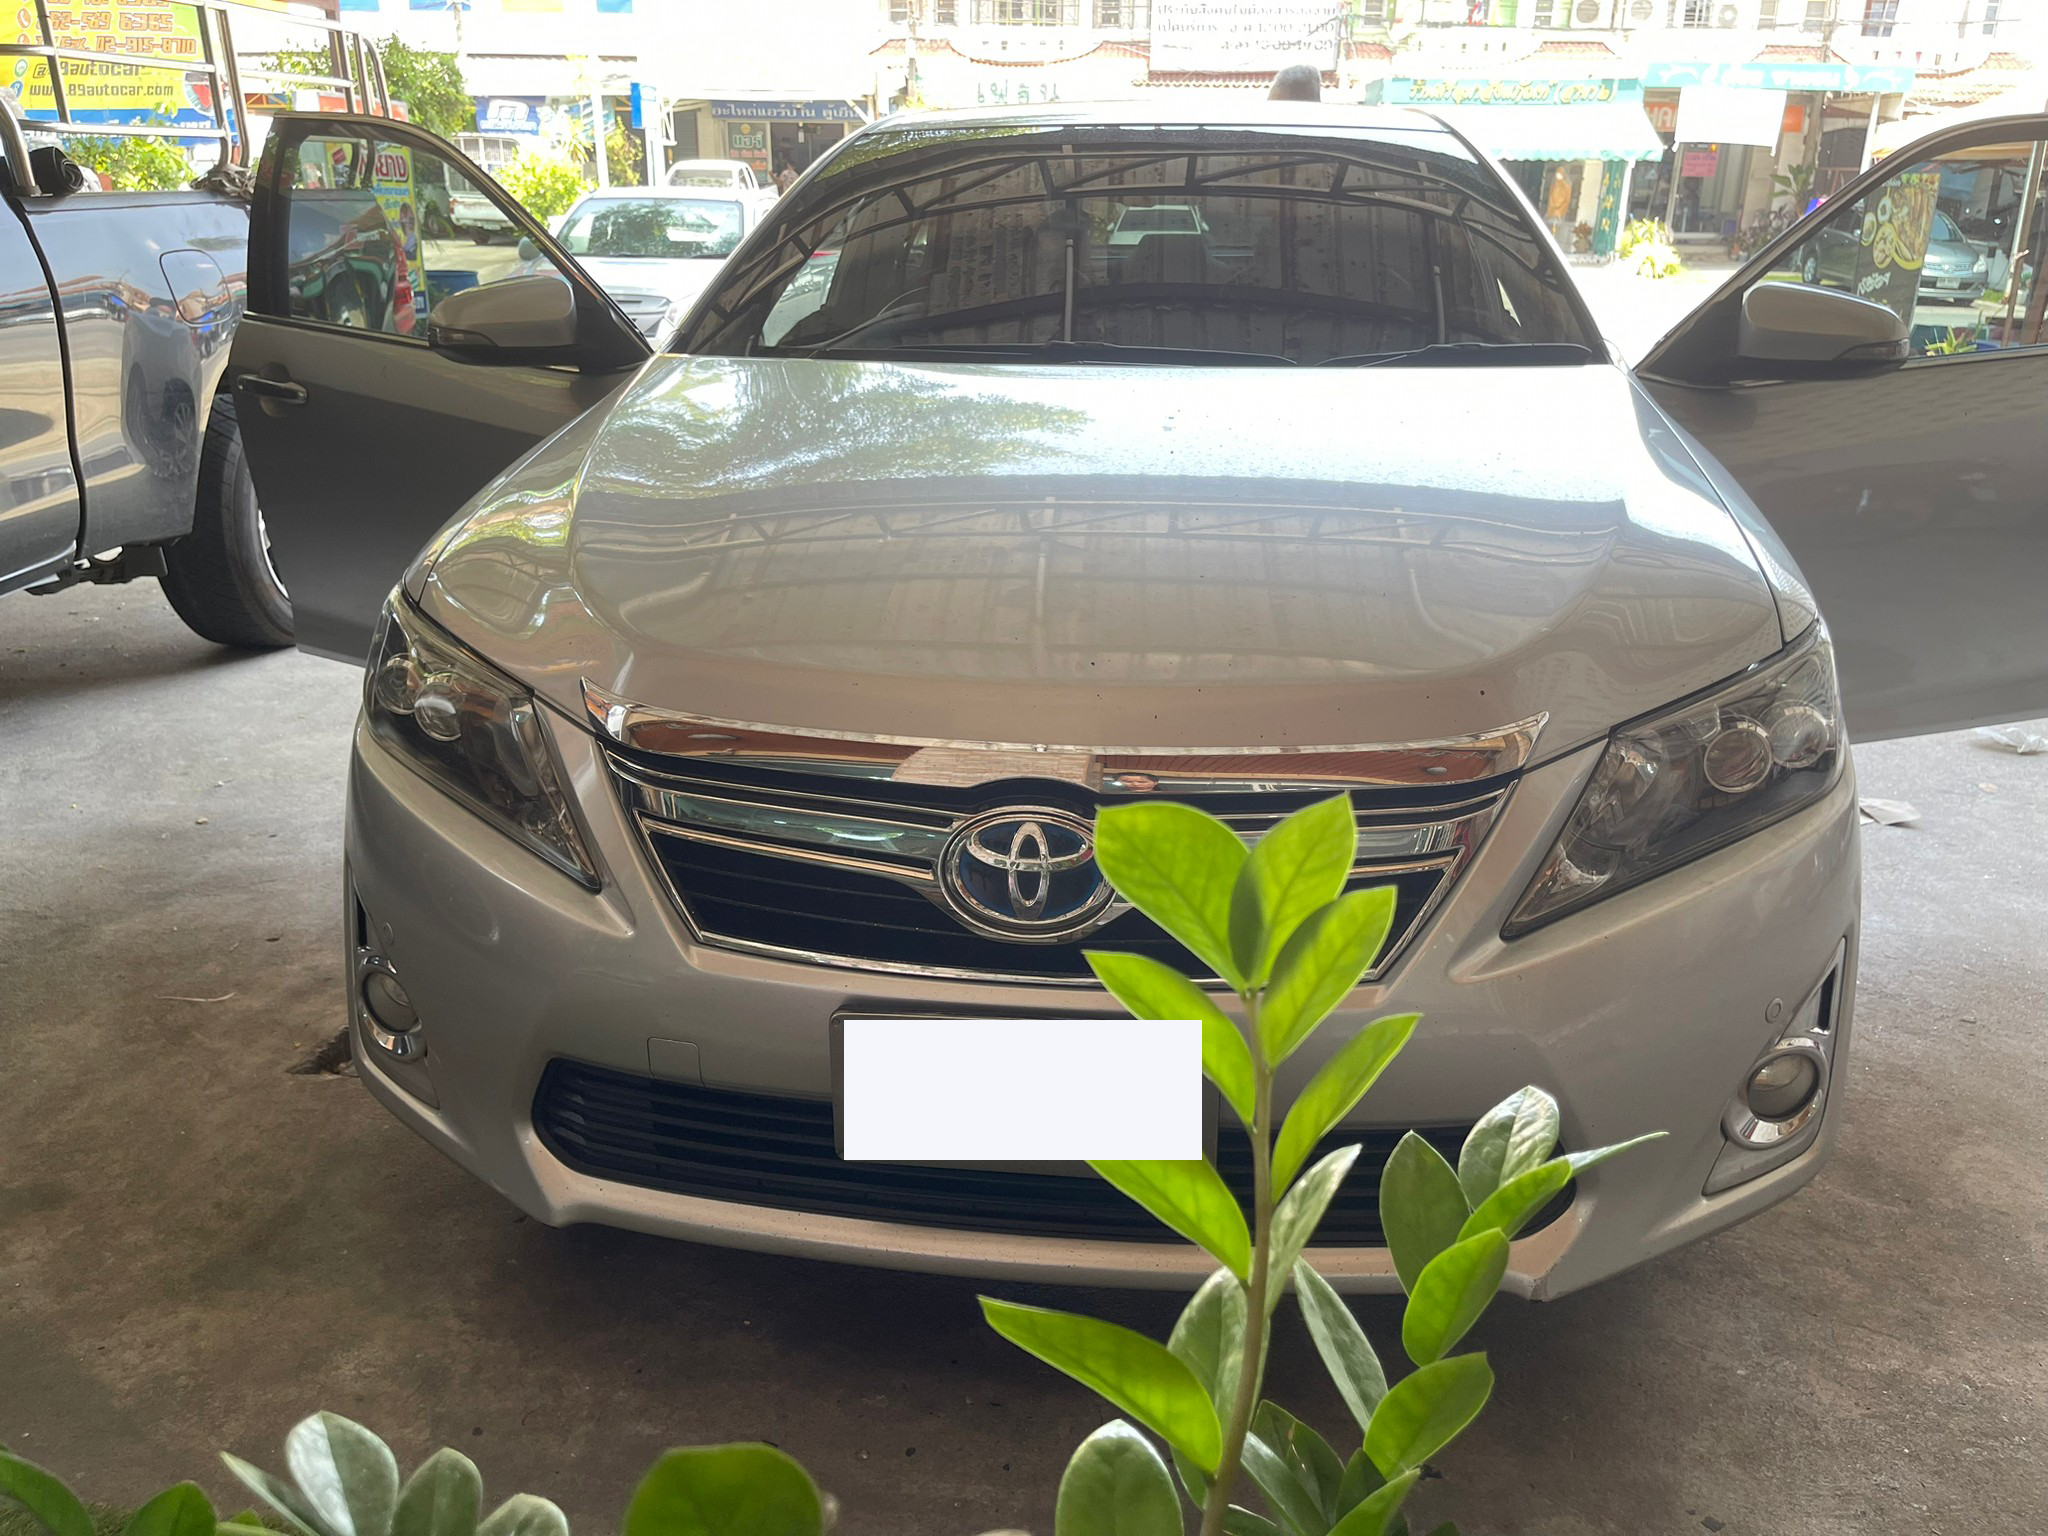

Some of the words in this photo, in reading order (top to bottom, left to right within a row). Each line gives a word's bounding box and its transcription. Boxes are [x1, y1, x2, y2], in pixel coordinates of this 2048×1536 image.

[36, 12, 111, 31] 62-569
[96, 36, 197, 54] 02-915-8710
[33, 61, 145, 78] @9autocar
[29, 84, 173, 97] ww.89autocar.com
[732, 131, 764, 148] แอร์
